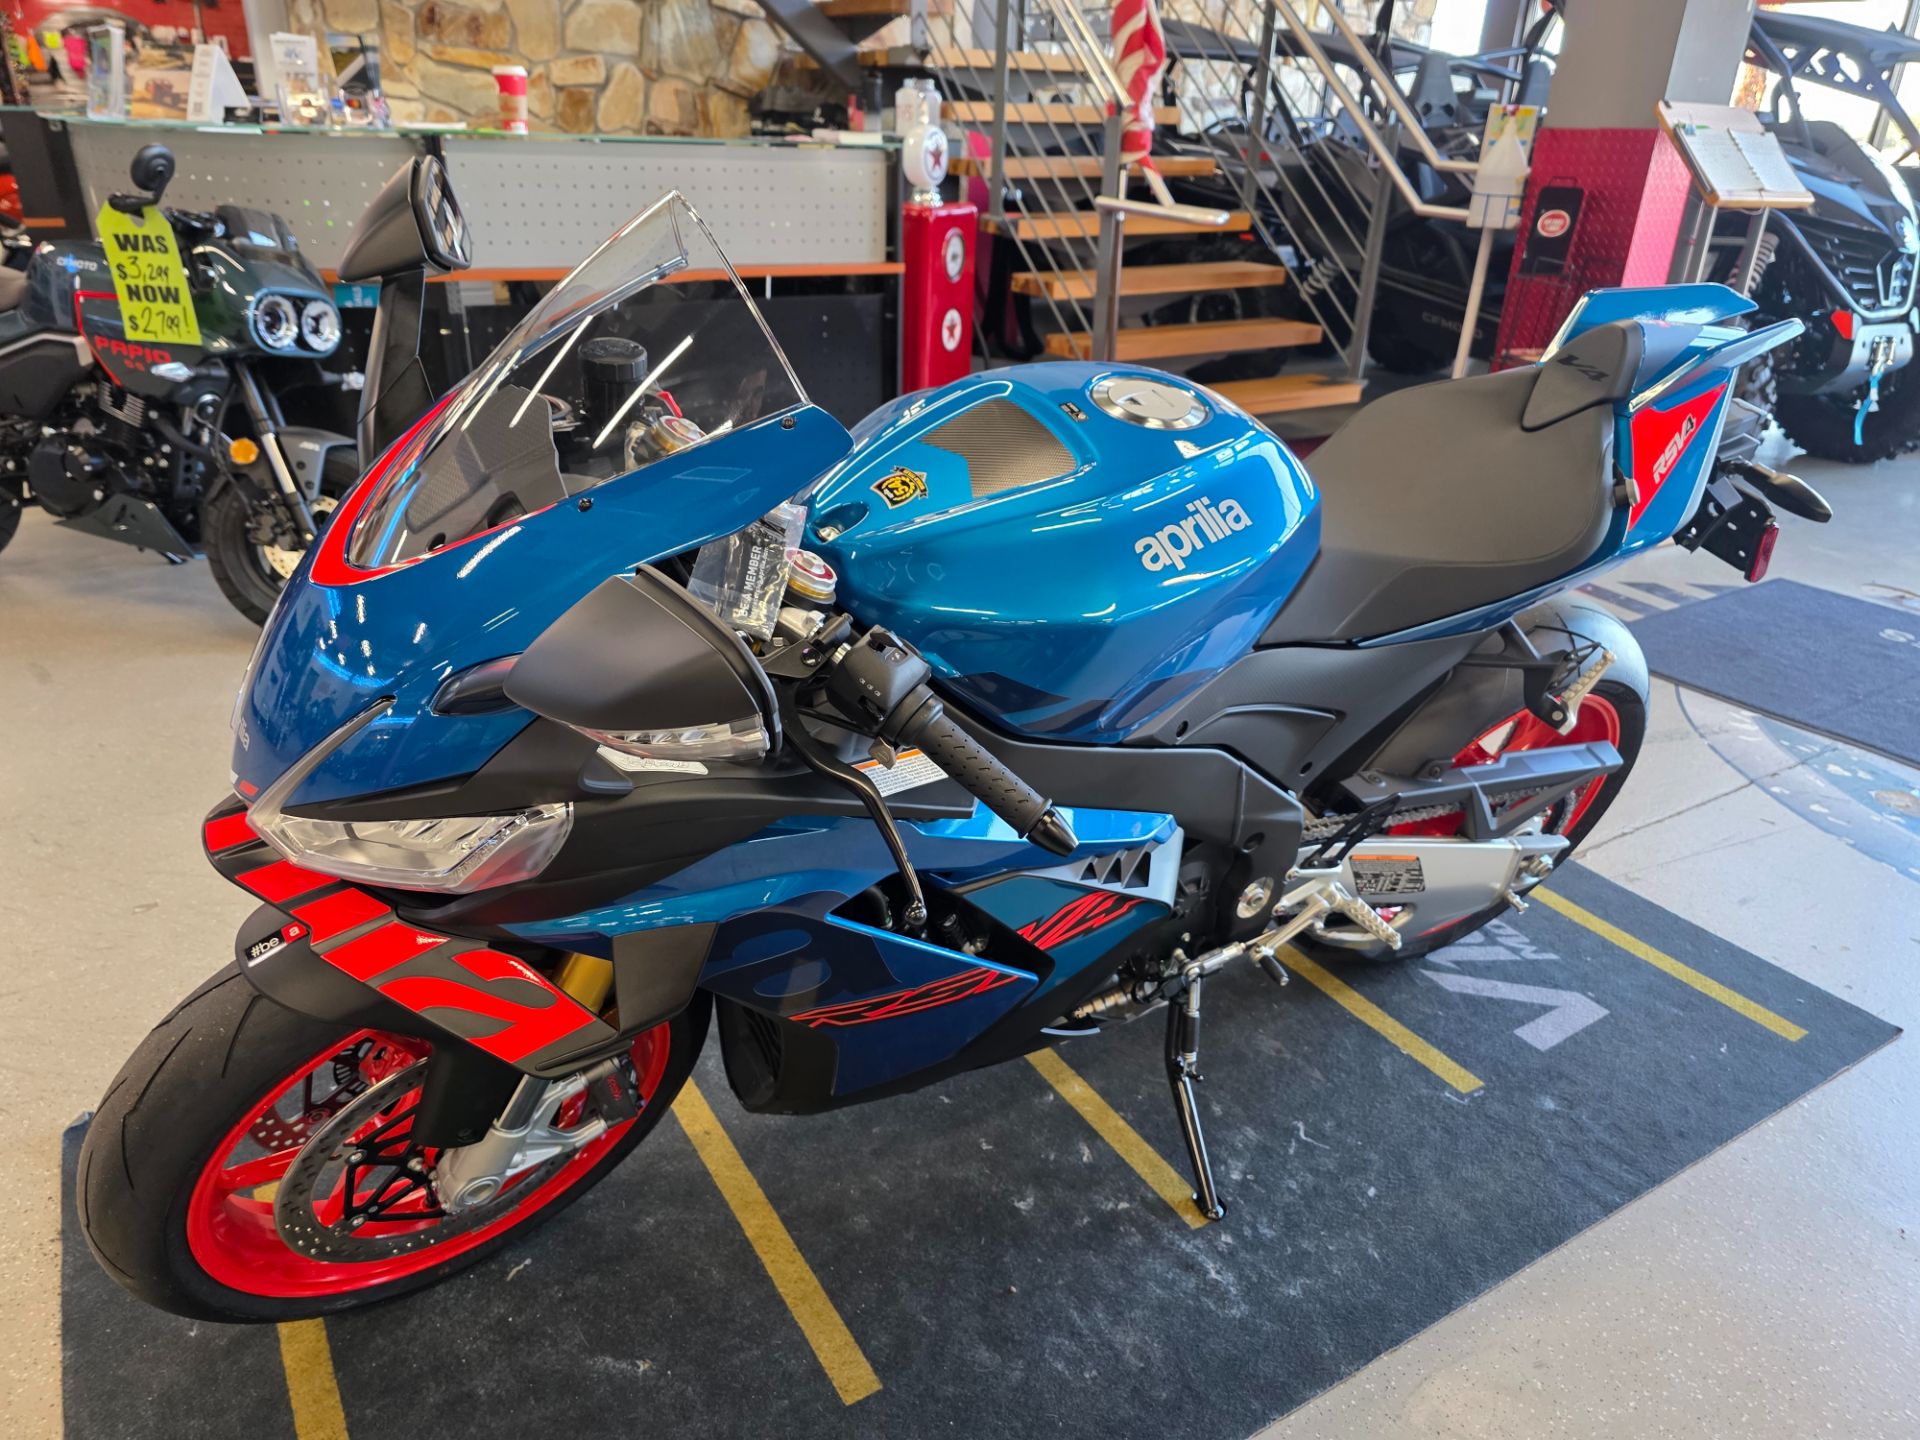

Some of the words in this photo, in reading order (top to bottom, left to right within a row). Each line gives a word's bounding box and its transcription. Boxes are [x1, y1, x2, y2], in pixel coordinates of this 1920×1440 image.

[113, 233, 169, 255] WAS
[126, 284, 181, 305] NOW
[94, 335, 172, 363] PAPIO
[1556, 354, 1609, 382] V4
[1652, 413, 1697, 484] RSV4
[1134, 496, 1253, 572] aprilia
[744, 545, 762, 594] MEMBER
[251, 937, 279, 957] #be
